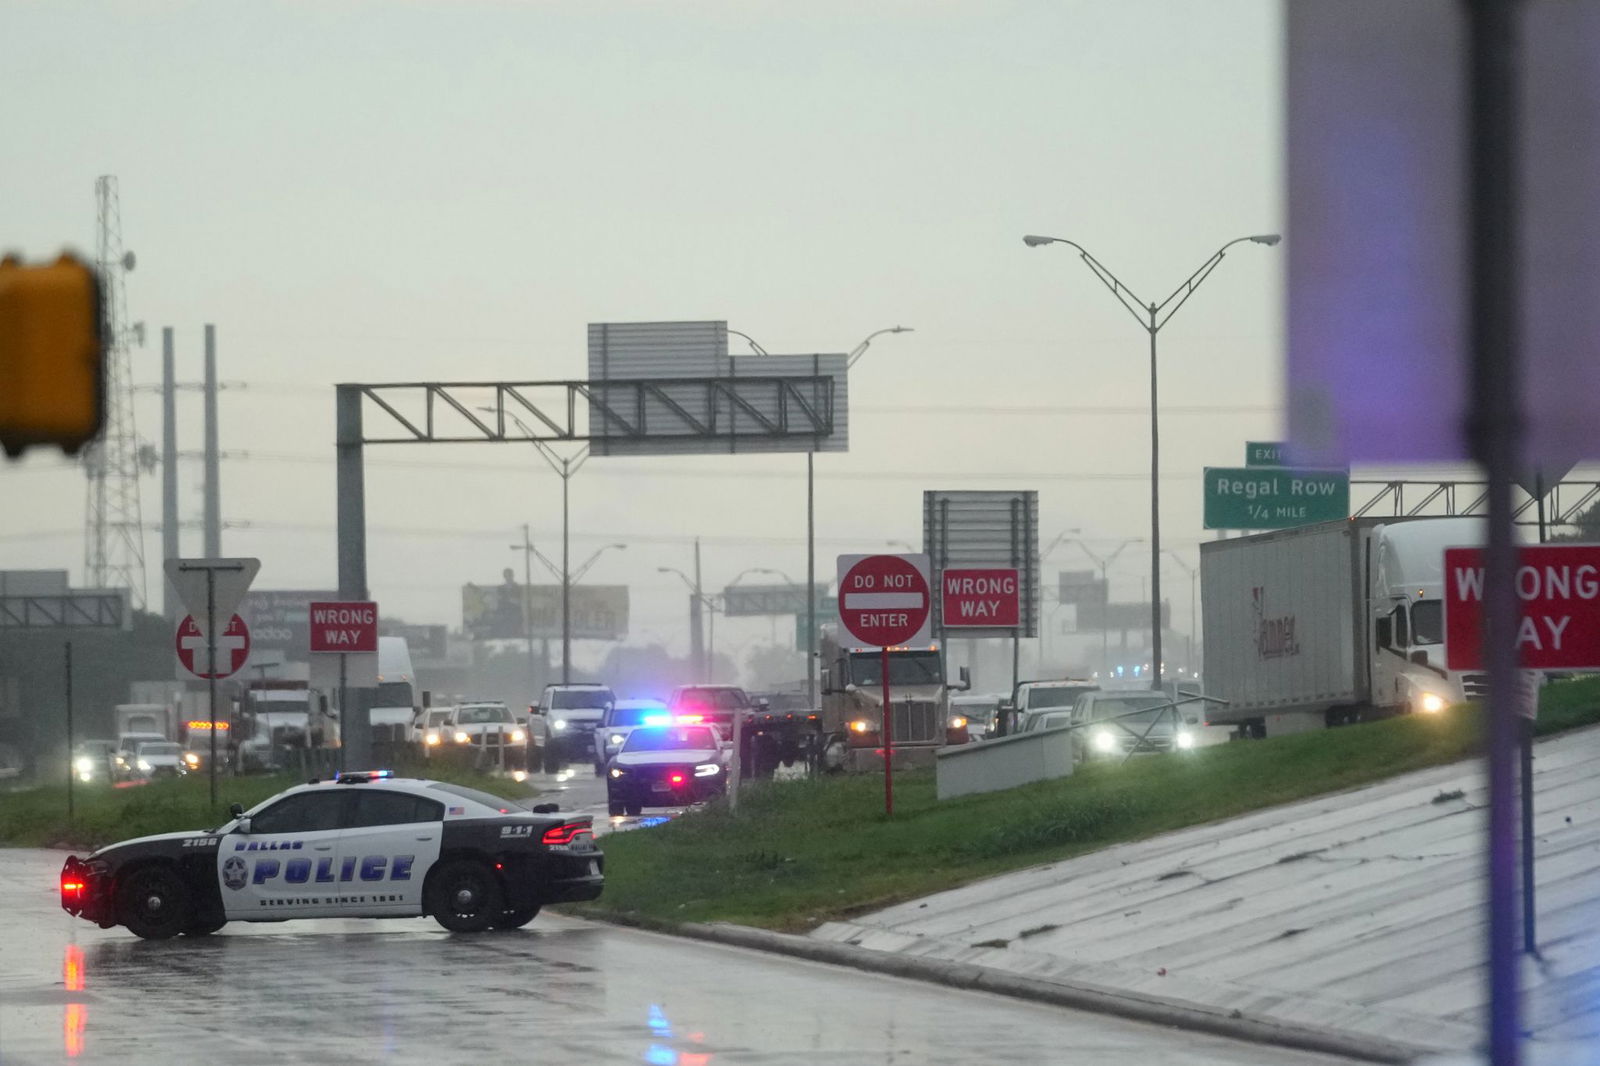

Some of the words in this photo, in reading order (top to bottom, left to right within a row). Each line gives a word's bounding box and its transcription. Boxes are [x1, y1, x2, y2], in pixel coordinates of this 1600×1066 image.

[1217, 478, 1279, 499] Regal
[1291, 479, 1336, 496] Row
[1276, 507, 1307, 518] MILE
[854, 575, 875, 589] DO
[883, 574, 914, 588] NOT
[946, 577, 1015, 595] WRONG
[1455, 564, 1599, 601] WONG
[313, 608, 374, 625] WRONG
[960, 601, 1001, 617] WAY
[860, 613, 908, 628] ENTER
[325, 629, 361, 645] WAY
[1514, 615, 1571, 651] AY
[234, 840, 304, 852] DALLAS
[252, 854, 416, 885] POLICE
[259, 897, 320, 907] SERVING
[325, 895, 366, 905] SINCE
